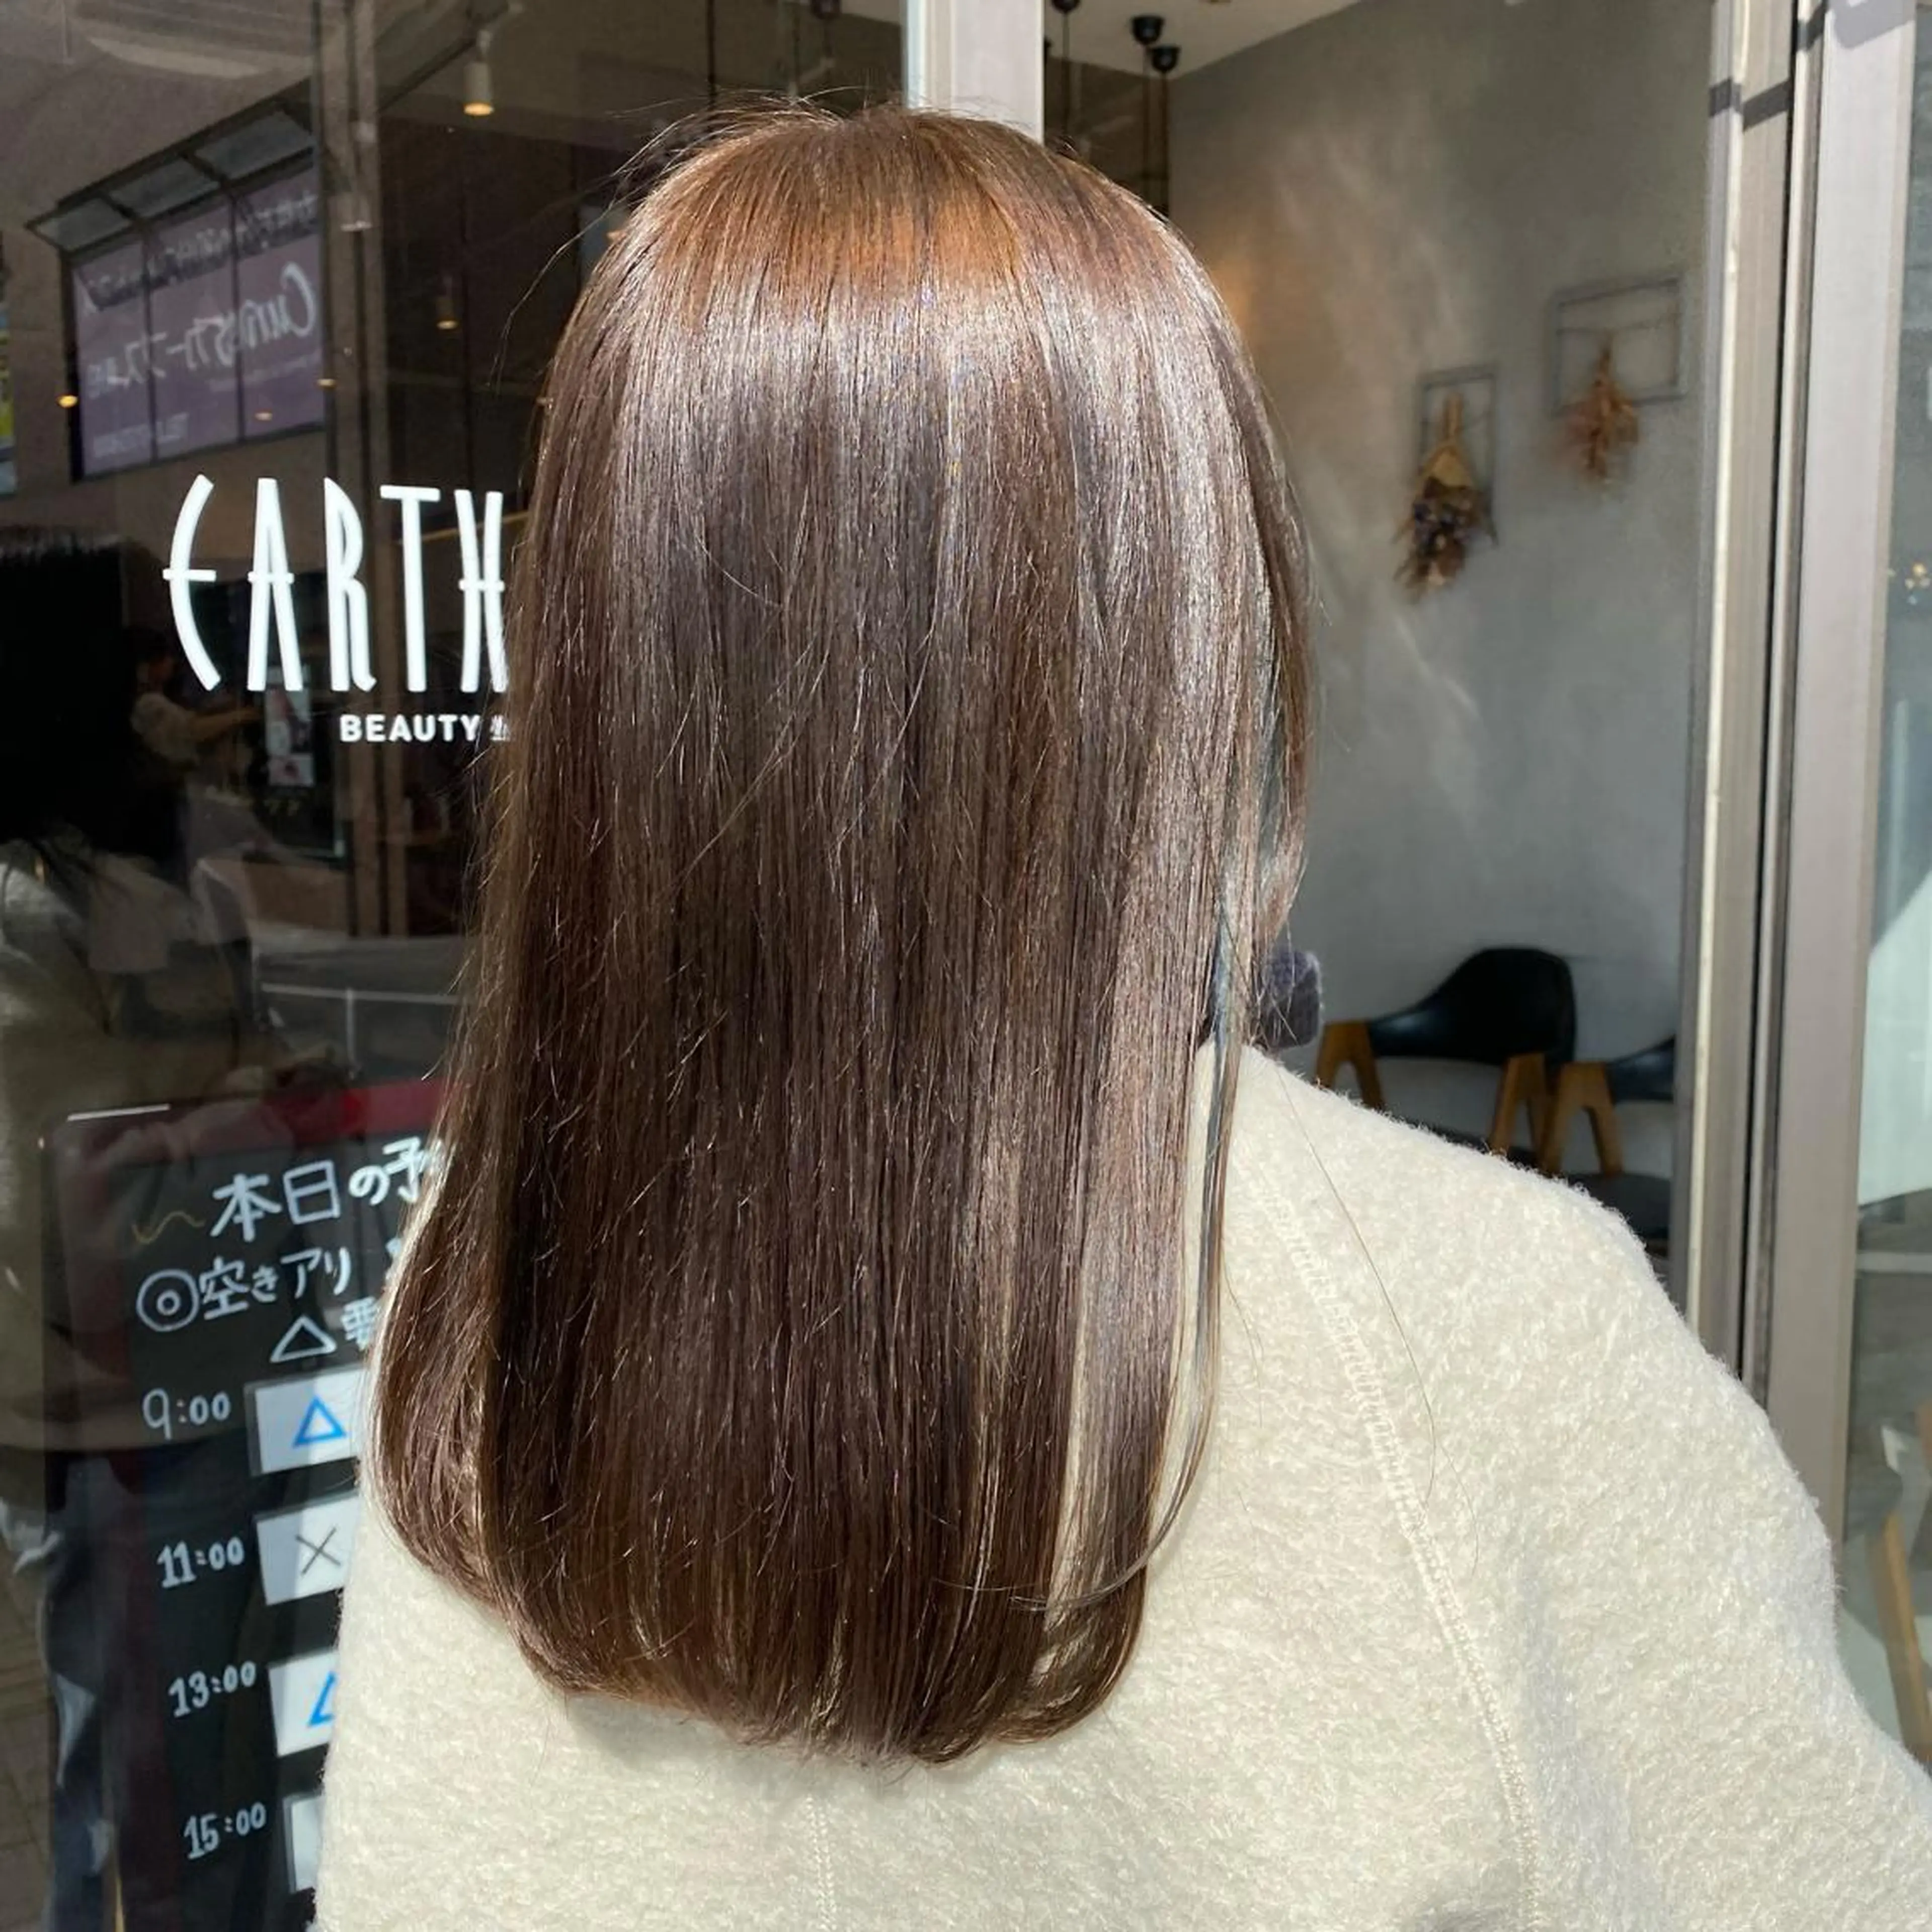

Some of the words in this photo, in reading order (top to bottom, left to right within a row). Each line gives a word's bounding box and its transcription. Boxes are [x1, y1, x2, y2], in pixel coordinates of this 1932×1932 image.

[163, 474, 508, 693] EARTH
[339, 714, 480, 742] BEAUTY
[142, 1388, 231, 1440] 9:00
[156, 1536, 245, 1588] 11:00
[168, 1660, 257, 1717] 13:00
[183, 1802, 267, 1860] 15:00
